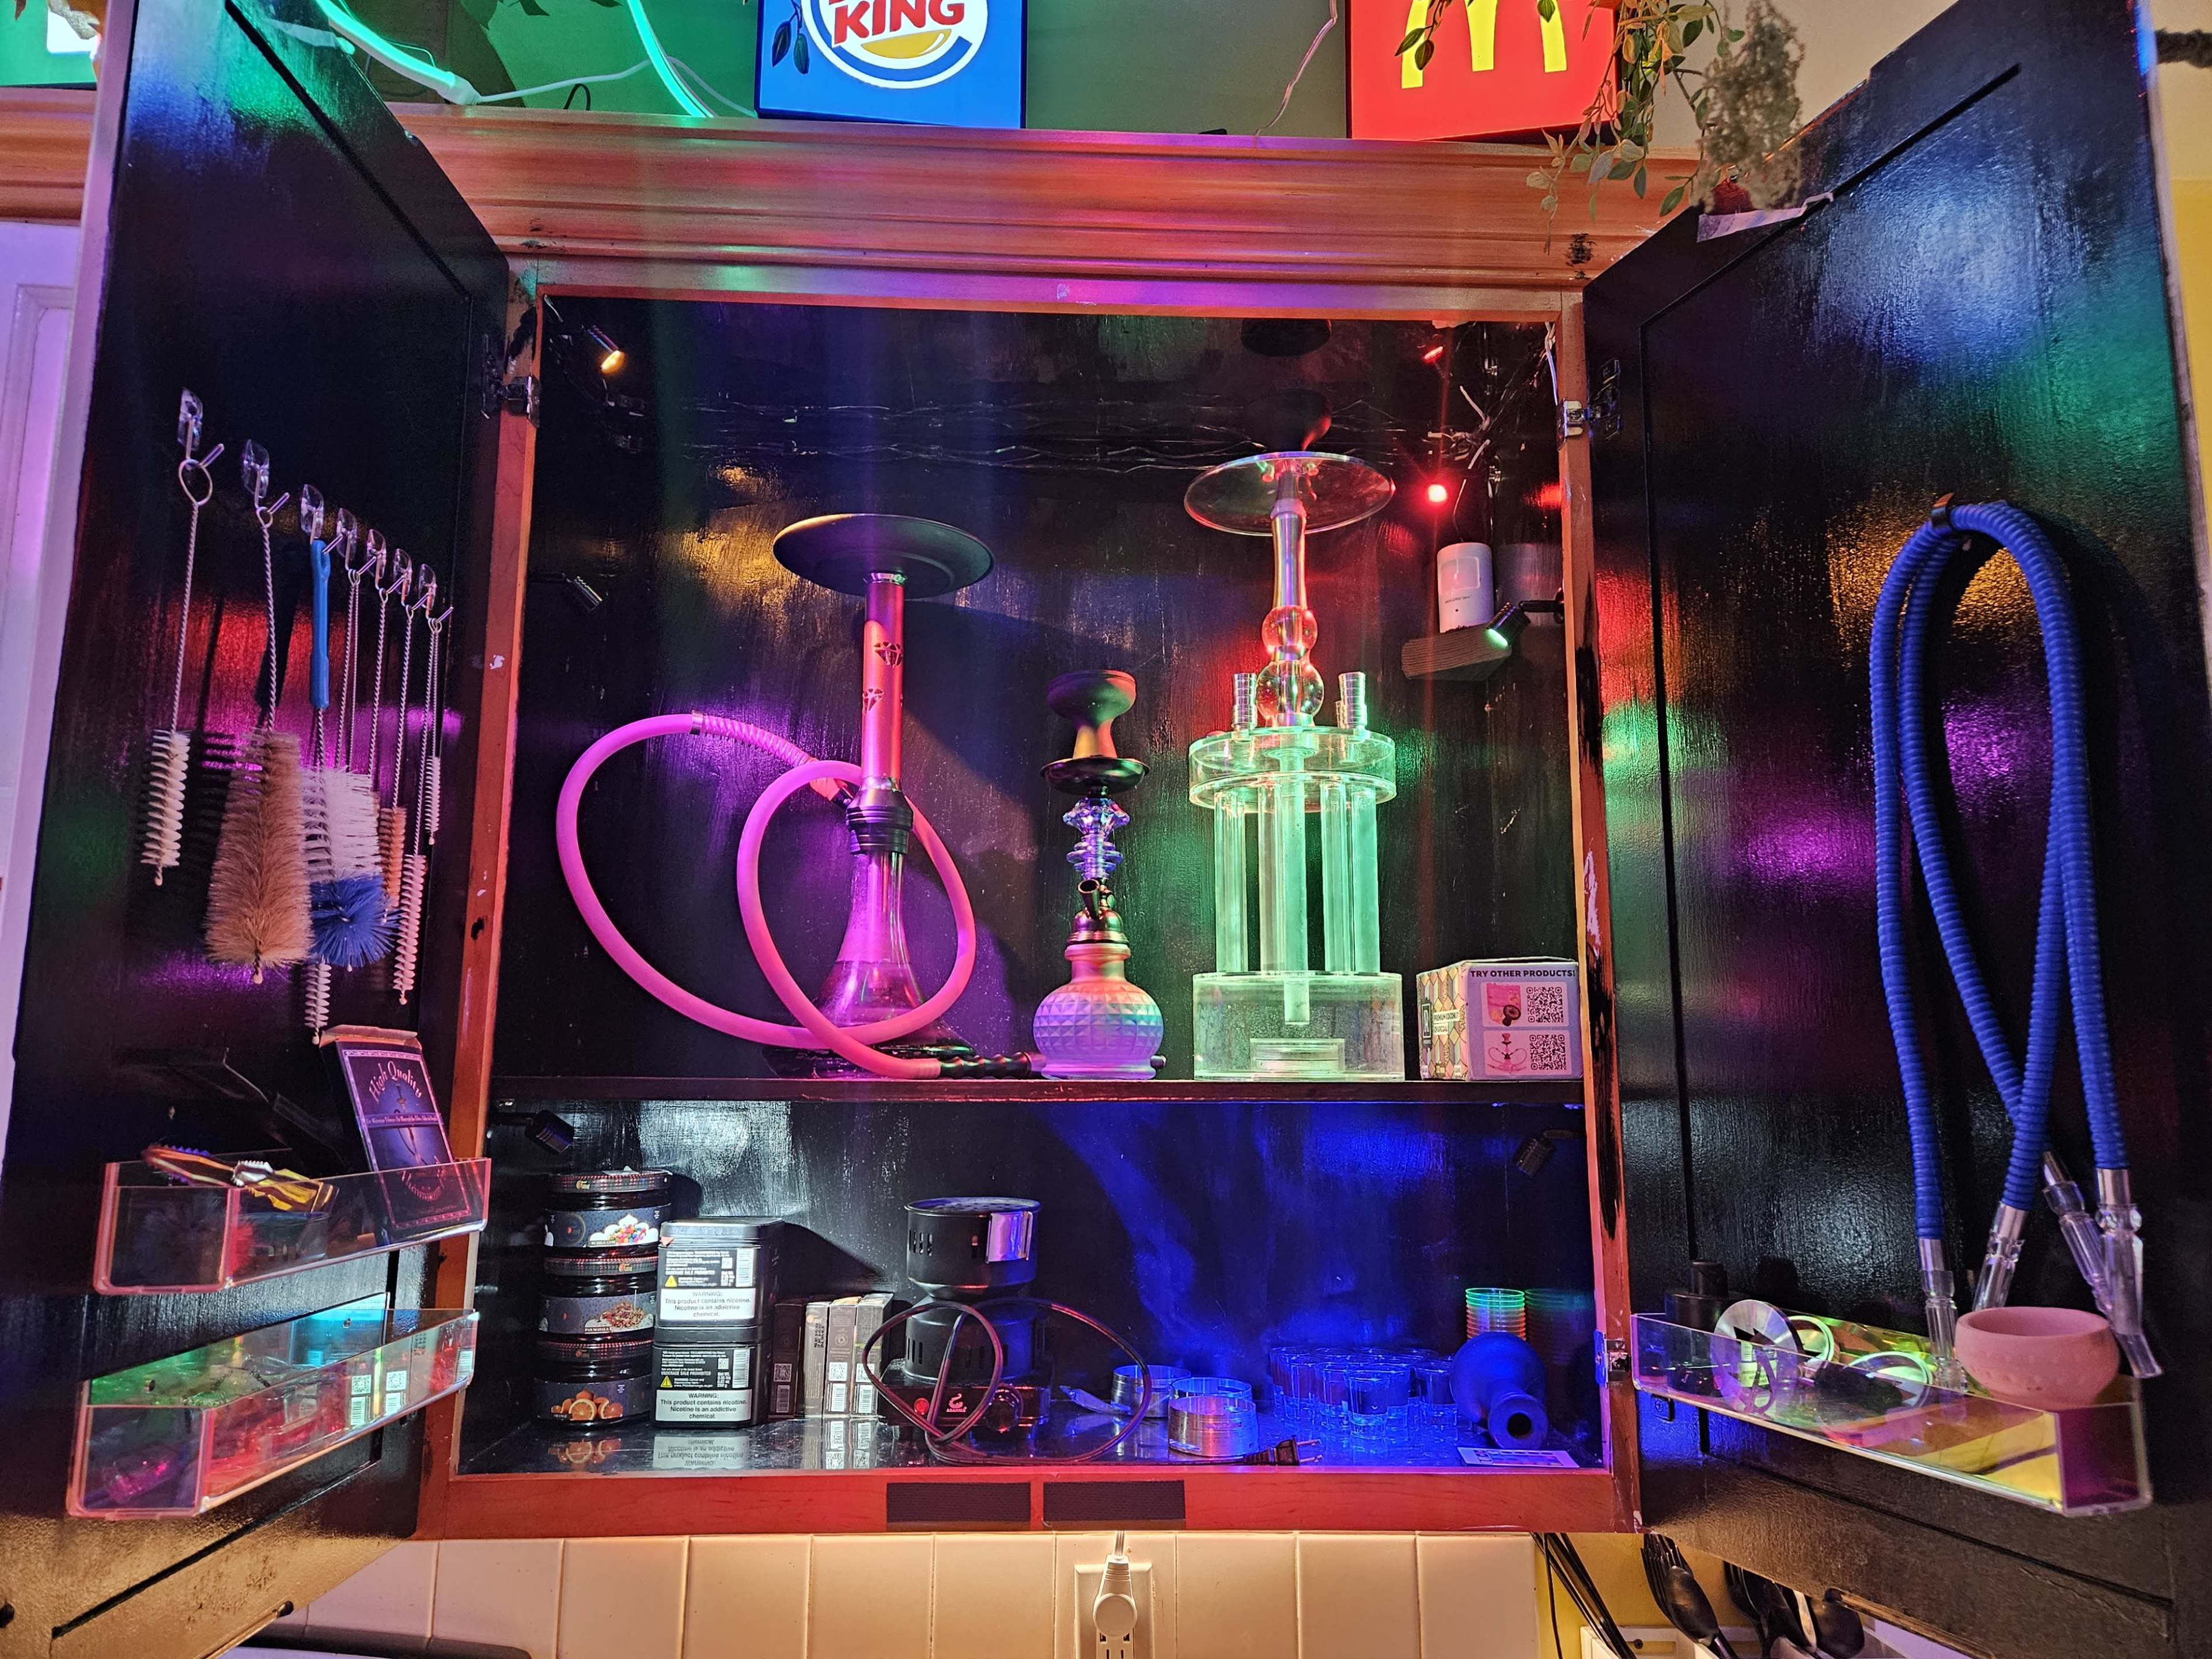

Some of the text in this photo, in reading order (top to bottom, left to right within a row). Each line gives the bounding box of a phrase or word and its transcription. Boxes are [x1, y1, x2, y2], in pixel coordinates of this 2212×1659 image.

[834, 0, 965, 44] KING
[369, 1060, 422, 1104] High Quality
